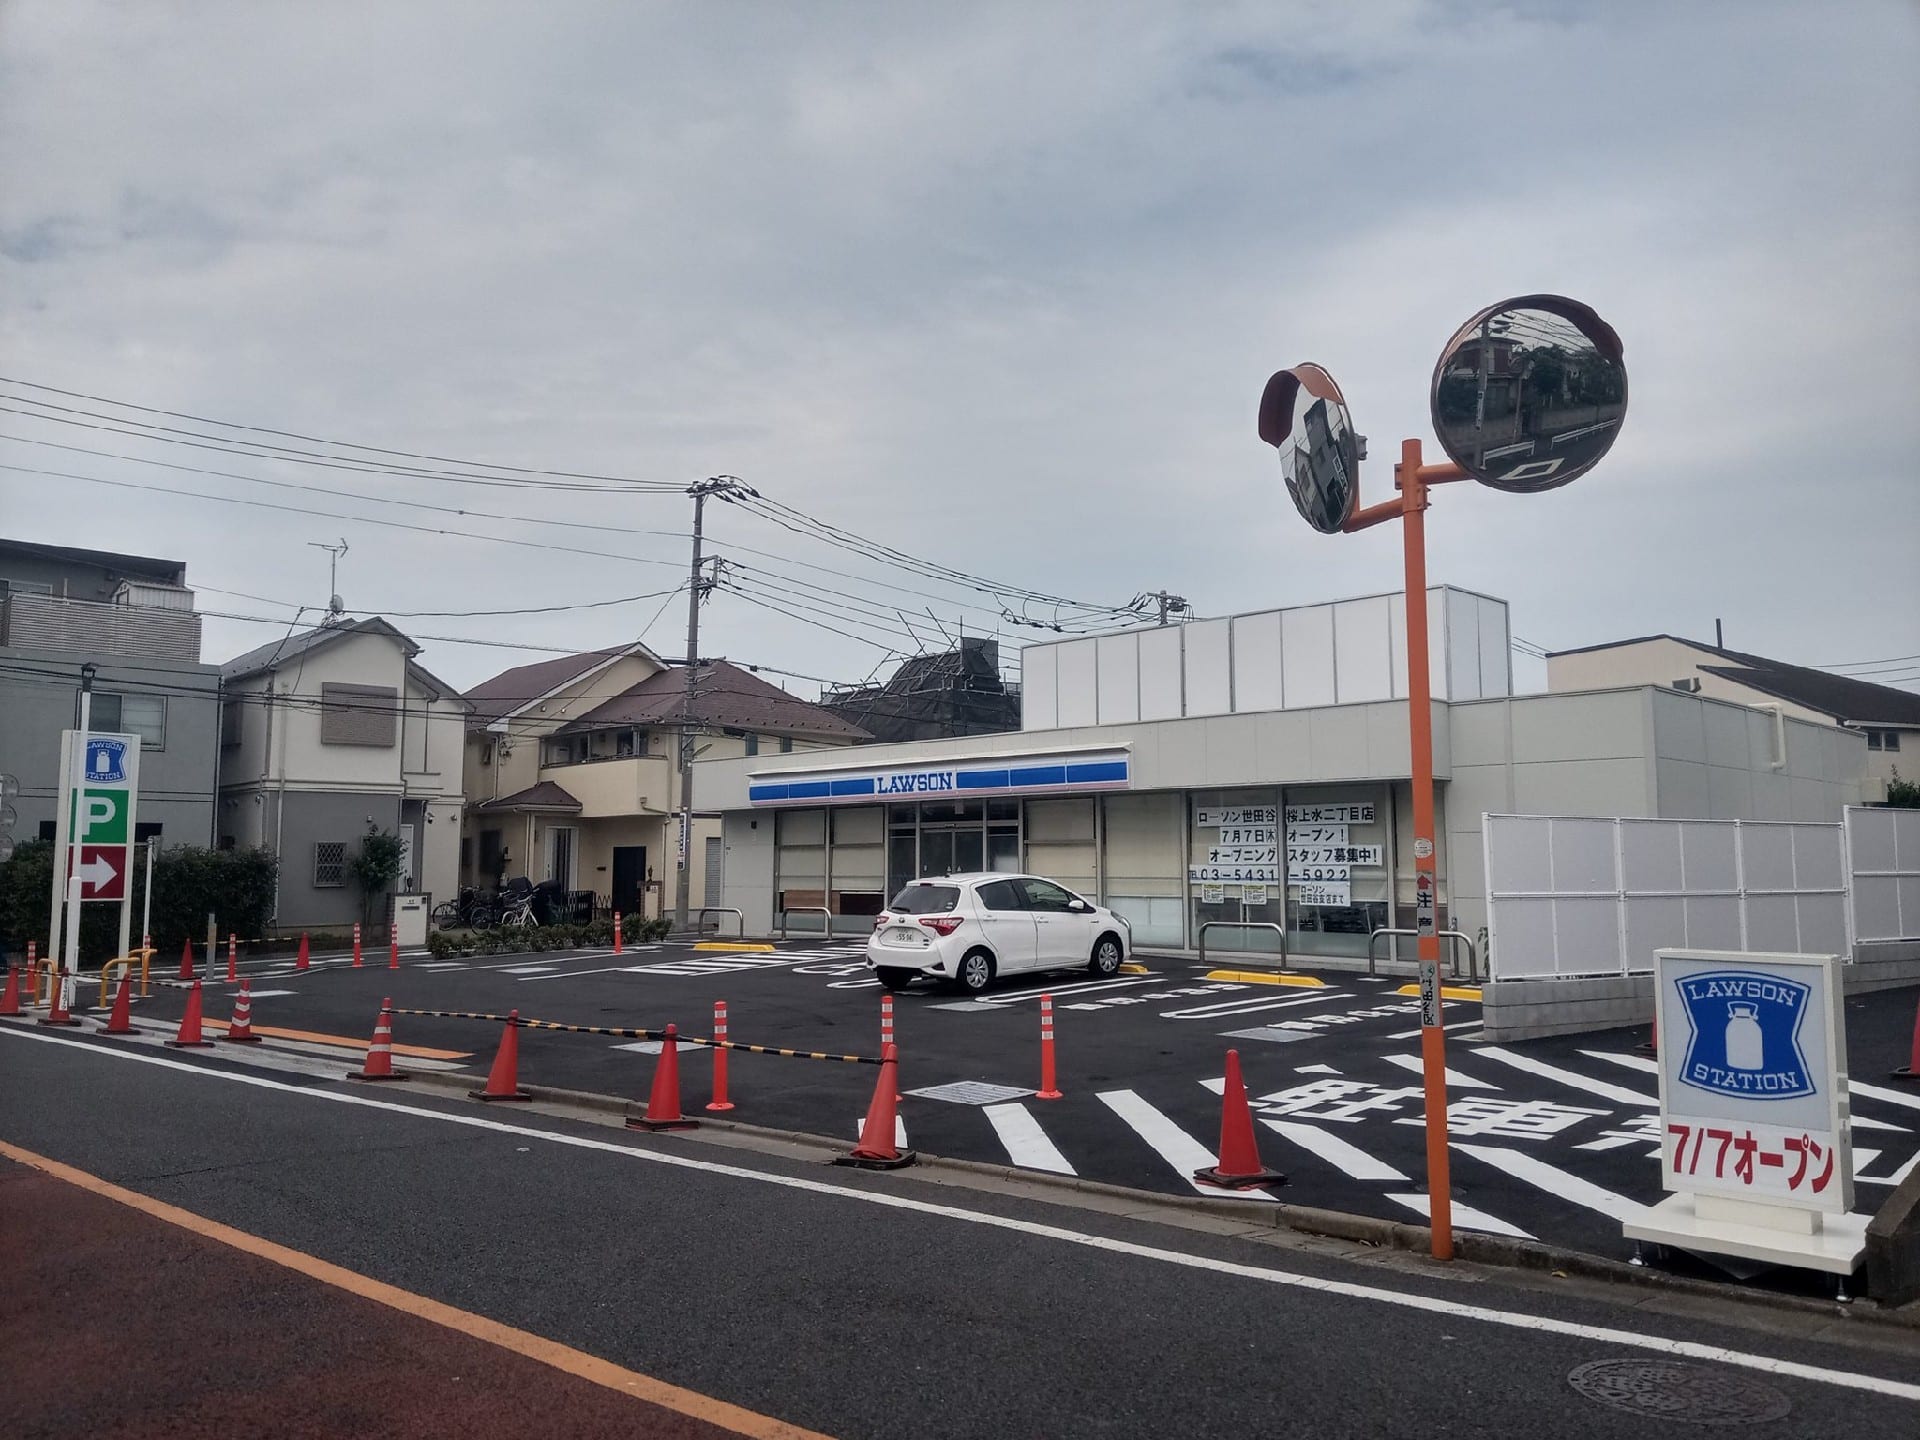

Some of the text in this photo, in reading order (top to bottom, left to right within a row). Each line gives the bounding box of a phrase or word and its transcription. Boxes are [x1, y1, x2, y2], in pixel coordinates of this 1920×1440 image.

[87, 742, 123, 751] AWSON
[877, 772, 953, 794] LAWSON
[82, 797, 116, 836] P
[1199, 806, 1374, 823] ローソン世田谷 桜上水二丁目店
[1688, 981, 1797, 1007] LAWSON
[1693, 1063, 1800, 1090] STATION
[1667, 1123, 1834, 1194] 7/7オープン
